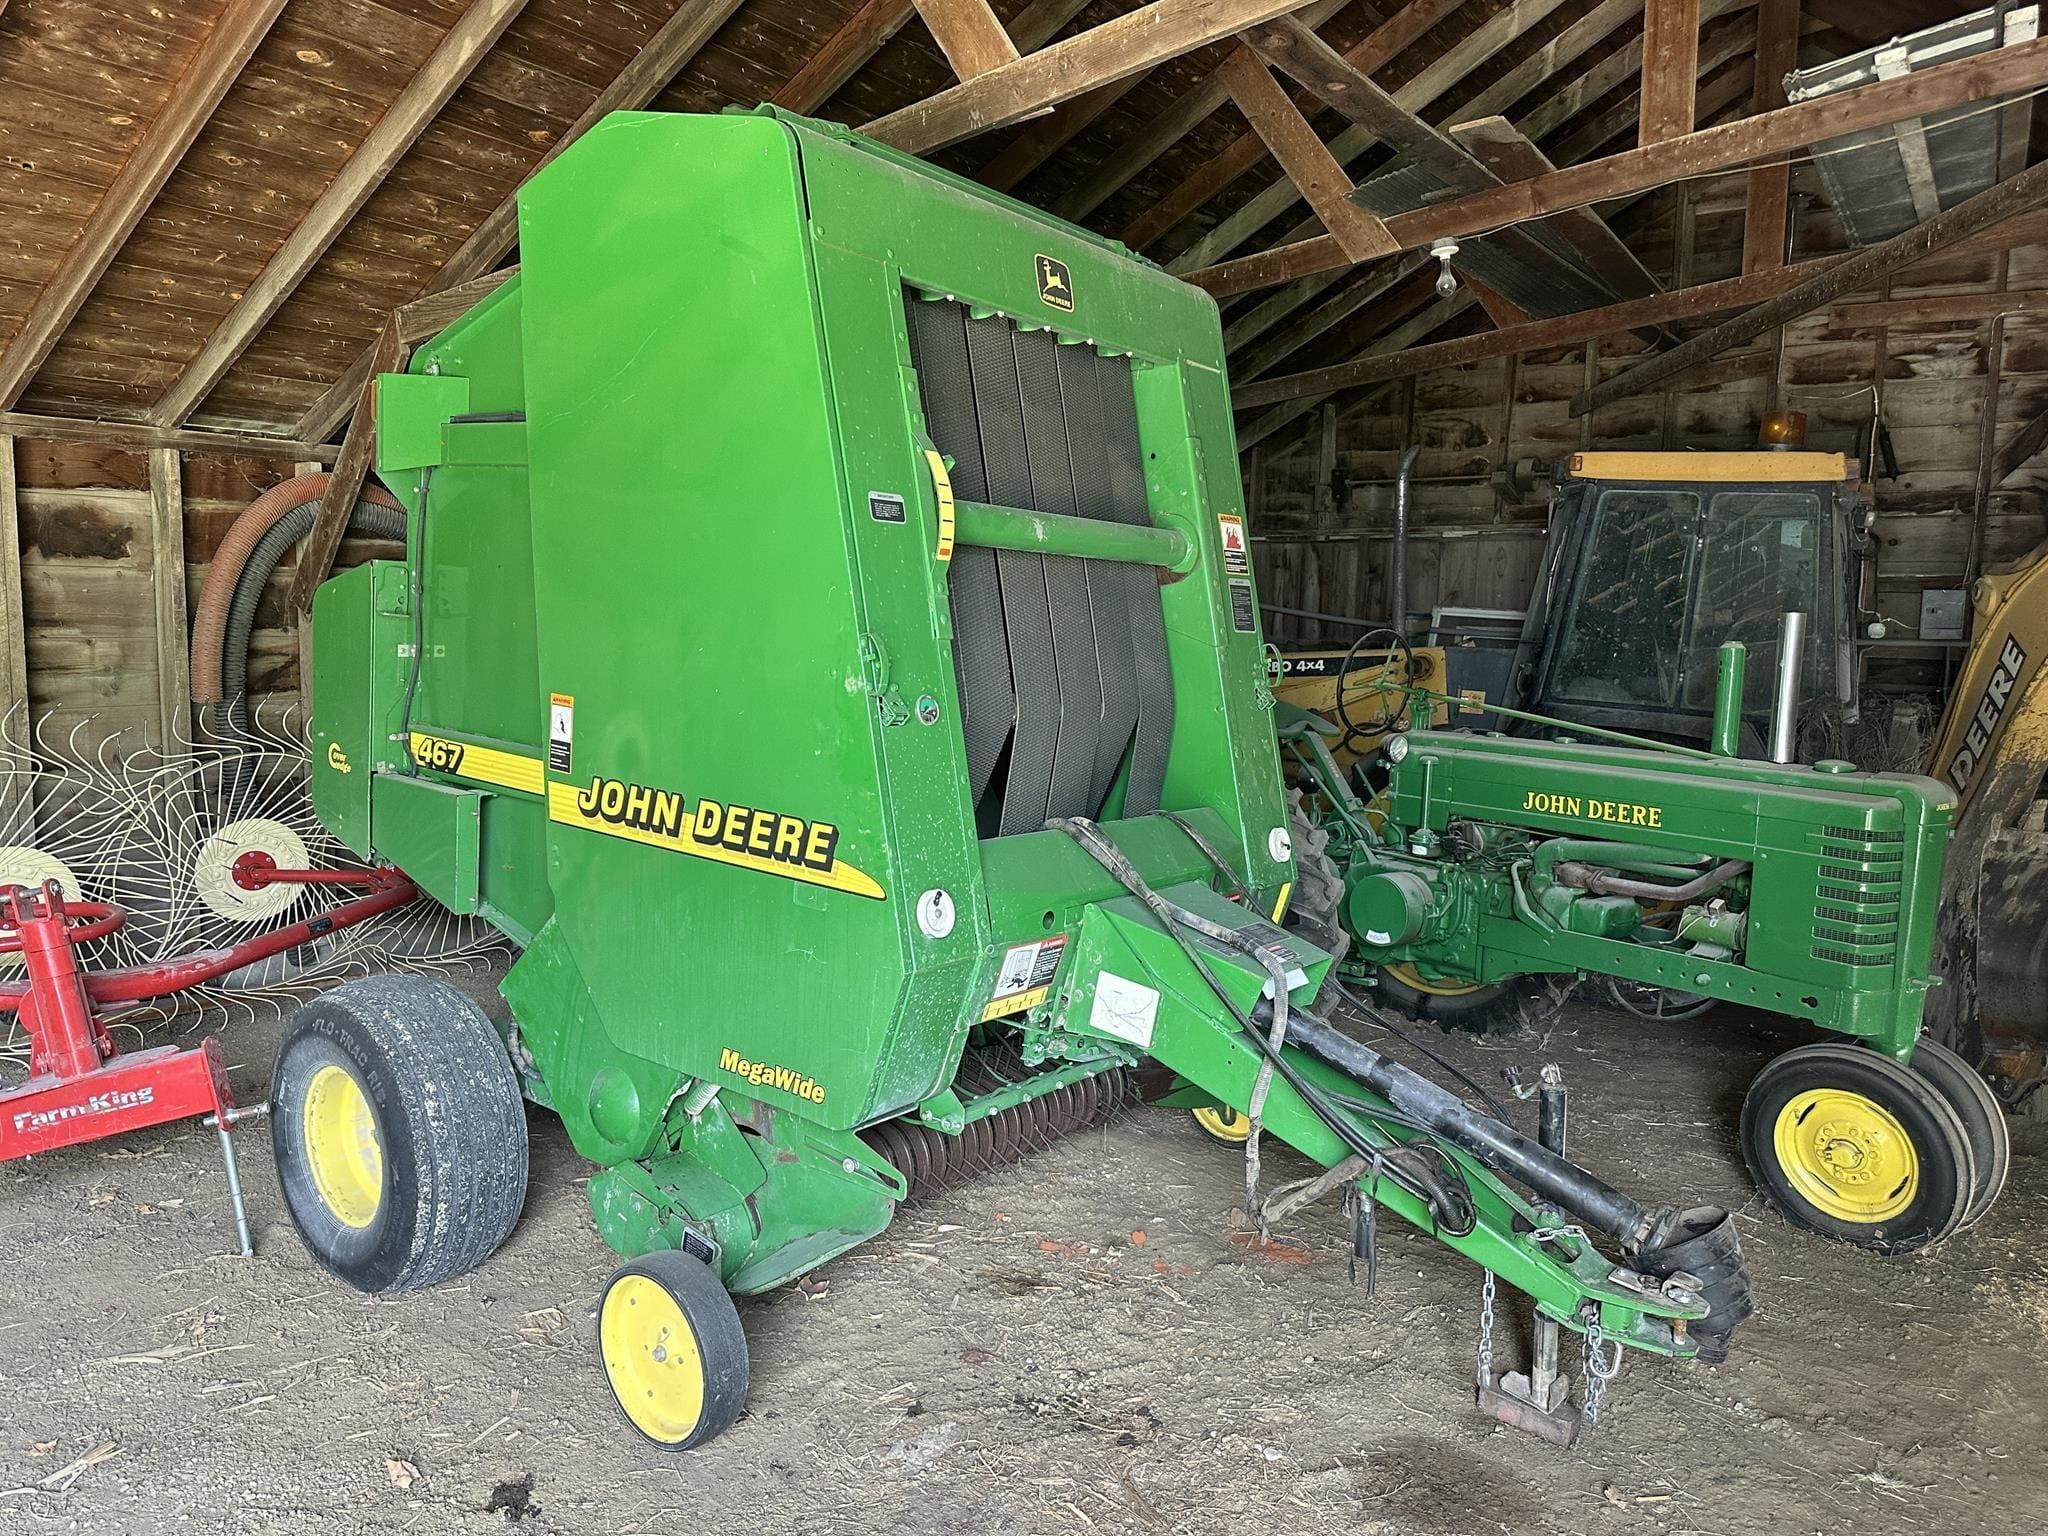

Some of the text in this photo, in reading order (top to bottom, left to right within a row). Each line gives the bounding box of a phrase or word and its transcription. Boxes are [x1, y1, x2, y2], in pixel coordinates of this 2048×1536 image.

[1950, 639, 2024, 791] DEERE
[418, 738, 464, 774] 467
[578, 776, 840, 872] JOHN DEERE
[1522, 791, 1662, 828] JOHN DEERE
[313, 1018, 368, 1067] FLO-TRAC
[719, 1047, 826, 1105] MegaWide
